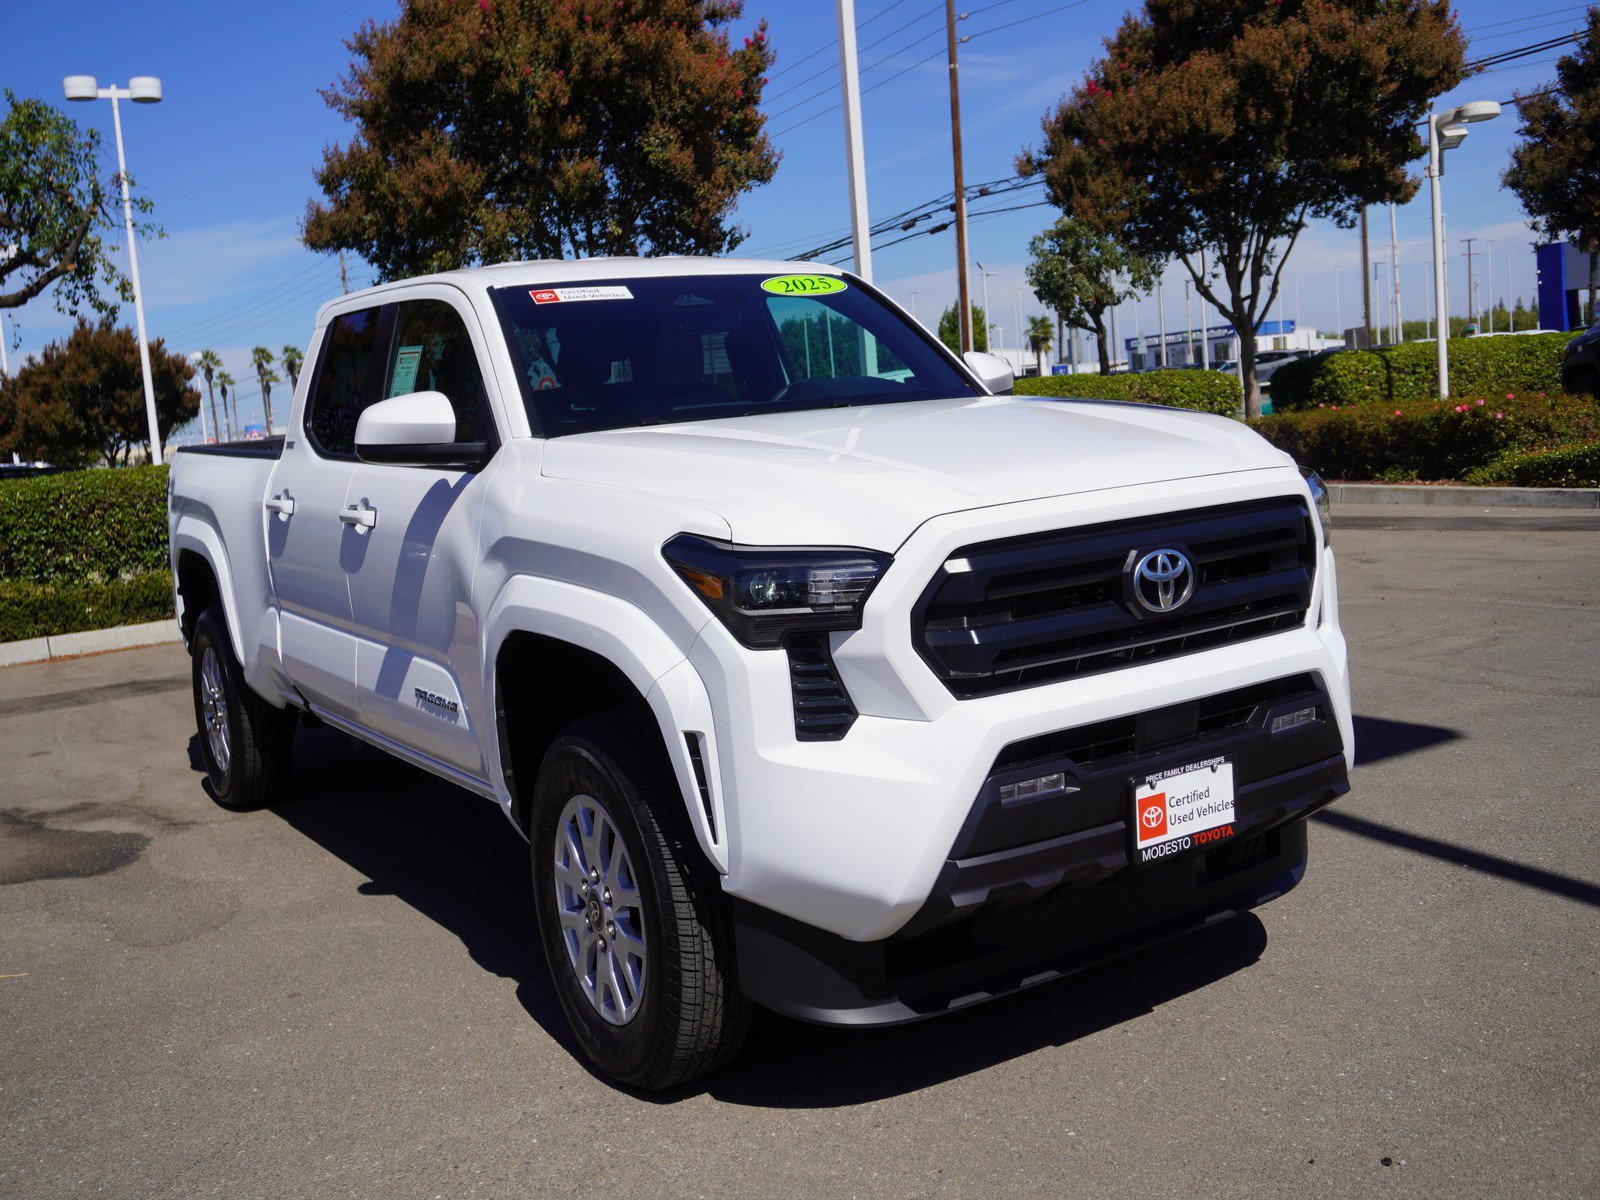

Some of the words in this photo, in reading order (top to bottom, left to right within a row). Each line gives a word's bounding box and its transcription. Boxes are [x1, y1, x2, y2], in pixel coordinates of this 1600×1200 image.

[778, 278, 832, 292] 2025
[1145, 773, 1162, 783] PRICE
[1163, 766, 1185, 778] FAMILY
[1185, 756, 1225, 771] DEALERSHIPS
[1168, 786, 1210, 808] Certified
[1169, 808, 1194, 826] Used
[1196, 799, 1236, 819] Vehicles
[1142, 837, 1191, 862] MODESTO
[1193, 825, 1234, 845] TOYOTA
